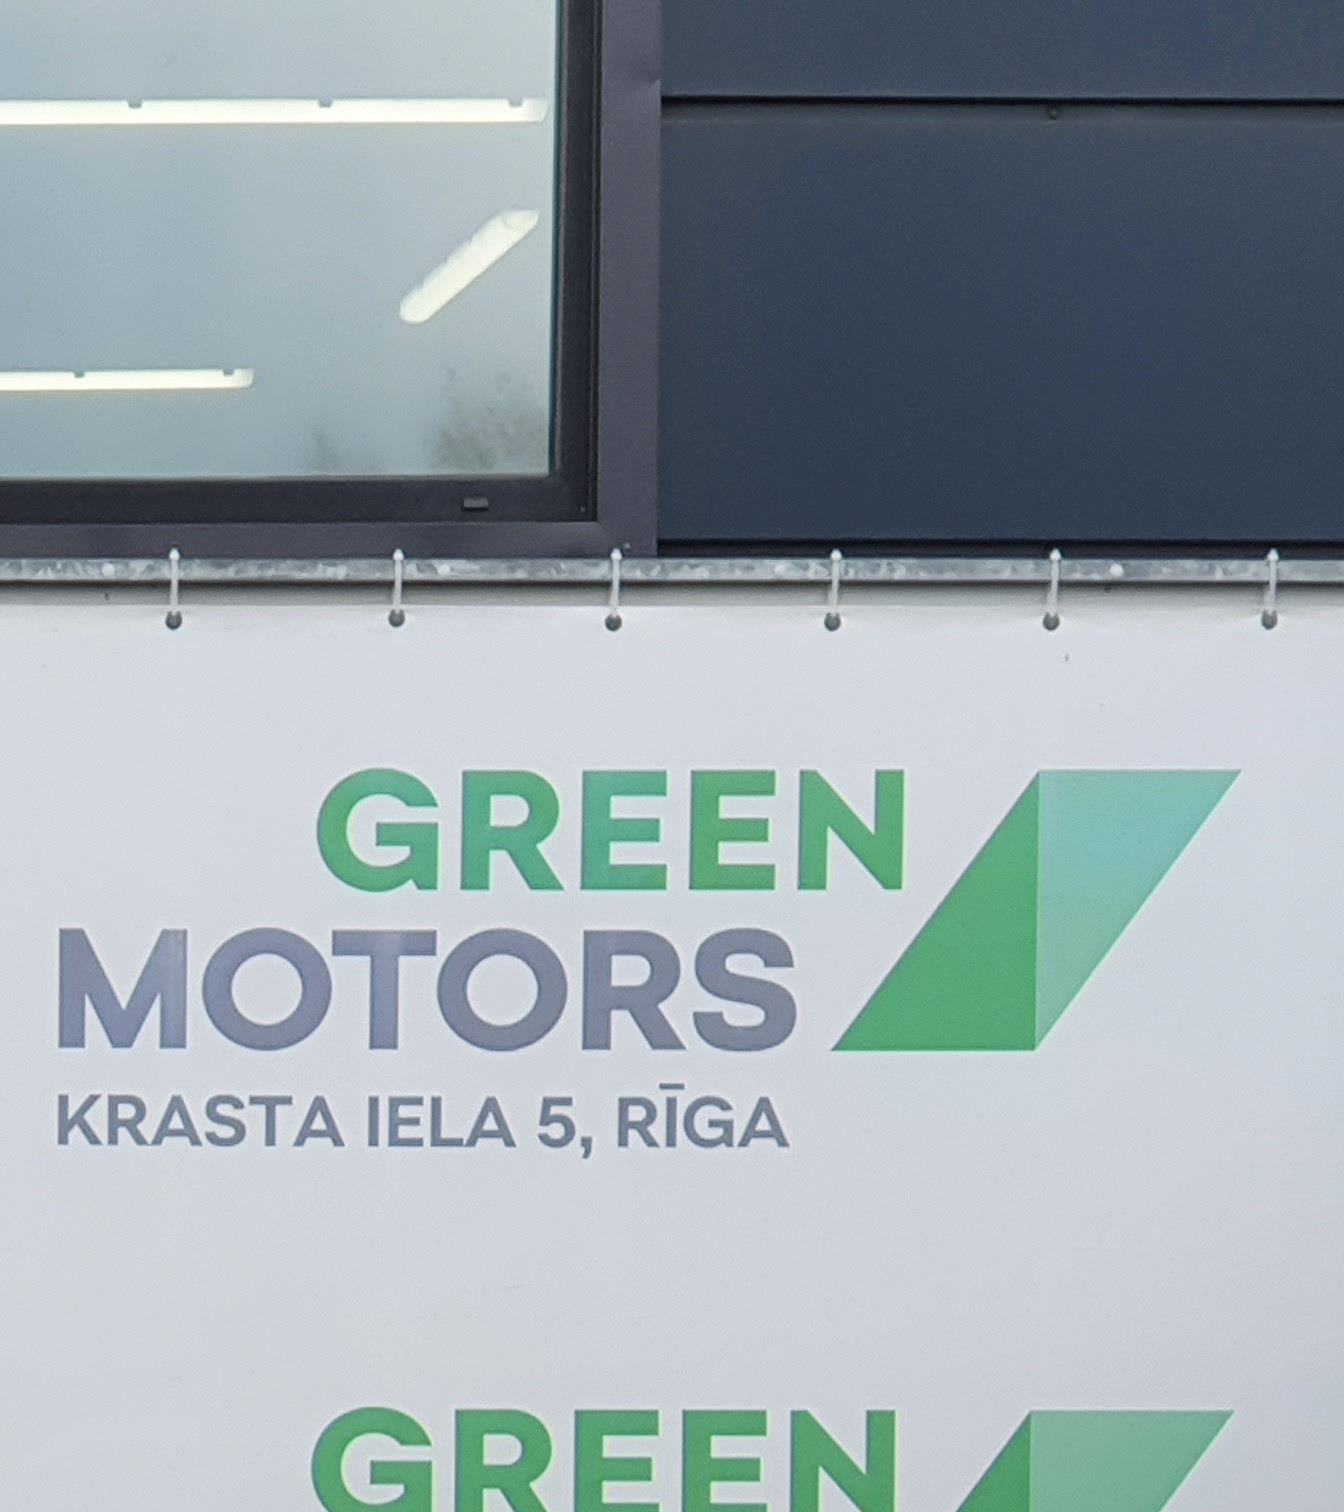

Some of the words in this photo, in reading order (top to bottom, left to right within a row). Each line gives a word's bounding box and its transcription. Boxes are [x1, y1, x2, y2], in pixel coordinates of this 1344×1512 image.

[316, 767, 905, 893] GREEN
[57, 927, 798, 1052] MOTORS
[56, 1094, 345, 1148] KRASTA
[367, 1095, 517, 1149] IELA
[537, 1096, 594, 1160] 5,
[617, 1083, 791, 1149] RĪGA
